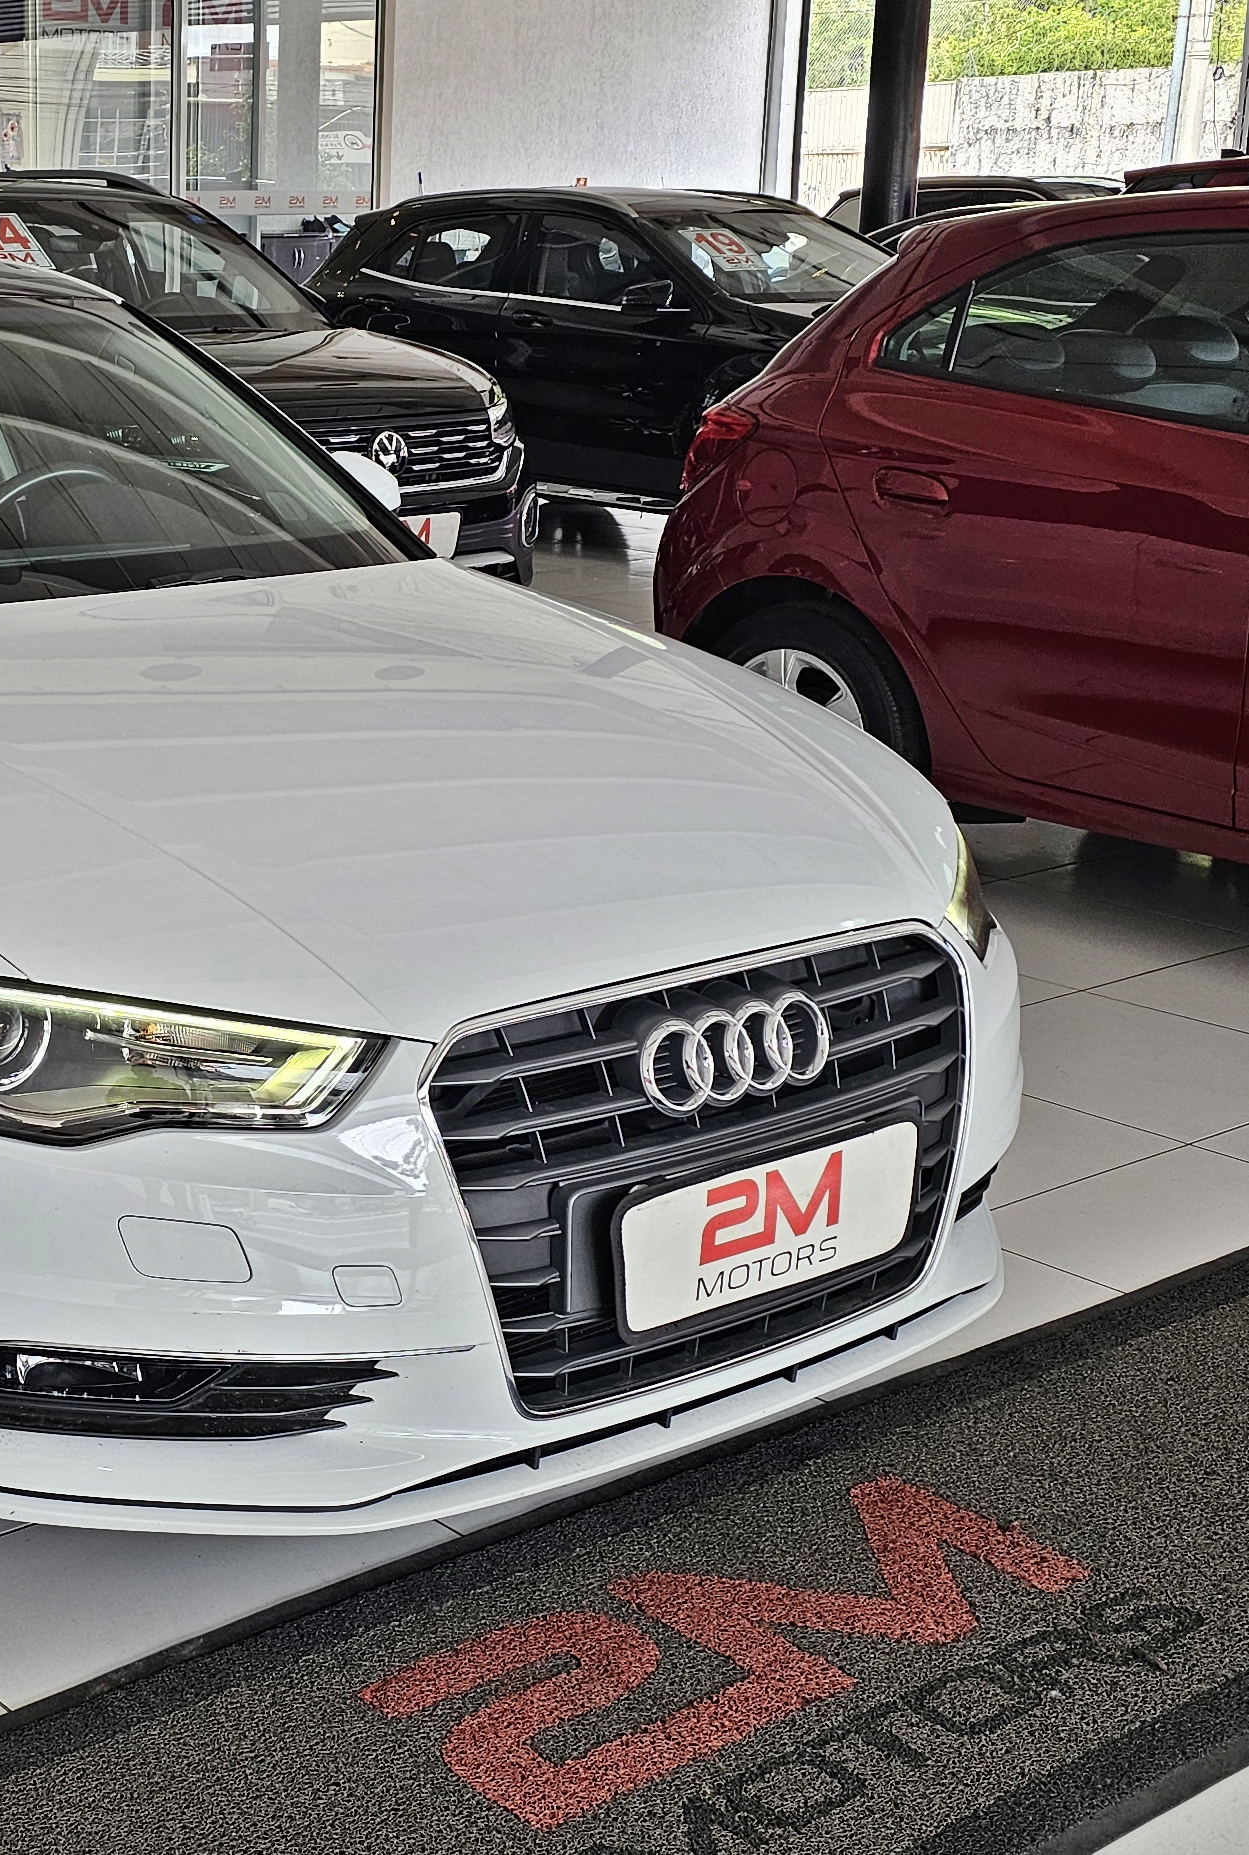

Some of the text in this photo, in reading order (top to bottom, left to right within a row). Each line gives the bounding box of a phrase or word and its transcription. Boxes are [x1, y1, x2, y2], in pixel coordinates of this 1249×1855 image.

[694, 231, 746, 255] 19
[699, 1149, 844, 1267] 2M
[695, 1235, 838, 1302] MOTORS
[357, 1473, 1090, 1832] 2M
